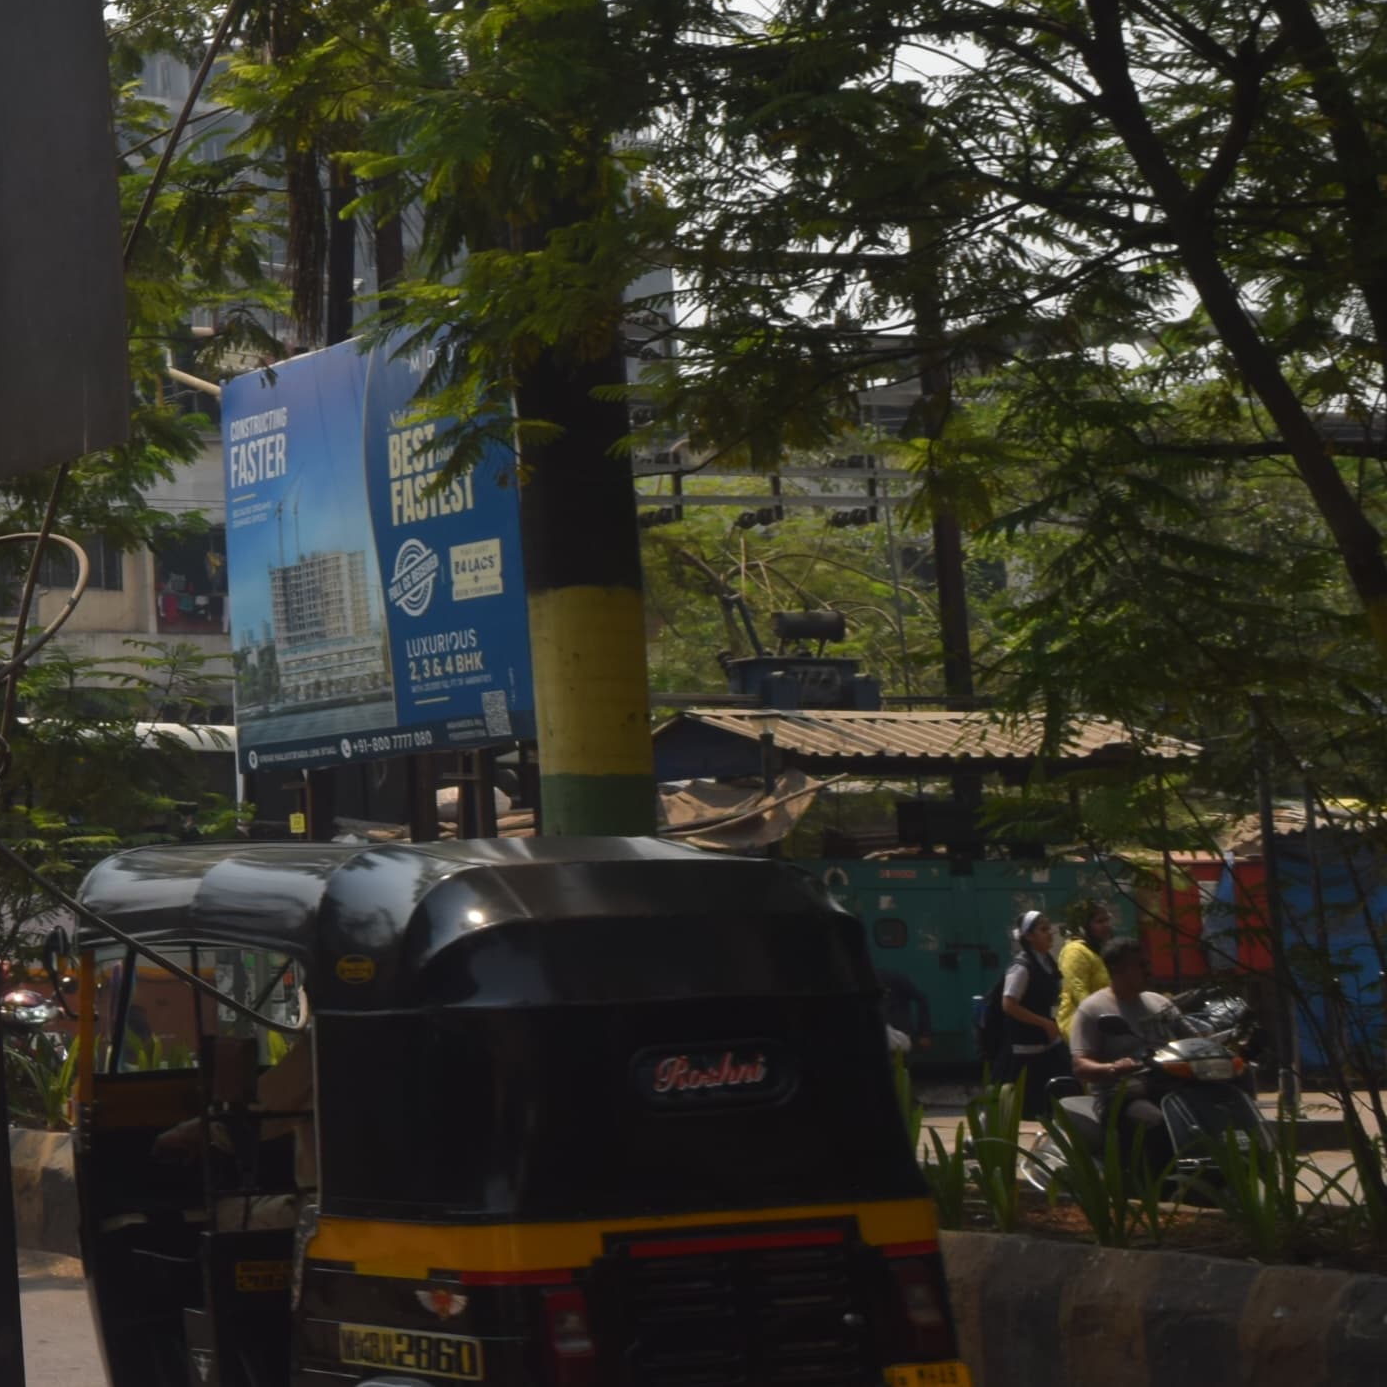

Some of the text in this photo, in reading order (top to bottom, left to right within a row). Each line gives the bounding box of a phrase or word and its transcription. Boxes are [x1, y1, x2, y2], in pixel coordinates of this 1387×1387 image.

[231, 433, 286, 488] FASTER
[388, 424, 435, 479] BEST
[406, 628, 476, 658] LUXURIOUS
[456, 650, 484, 673] BHK
[653, 1051, 767, 1093] Roshni
